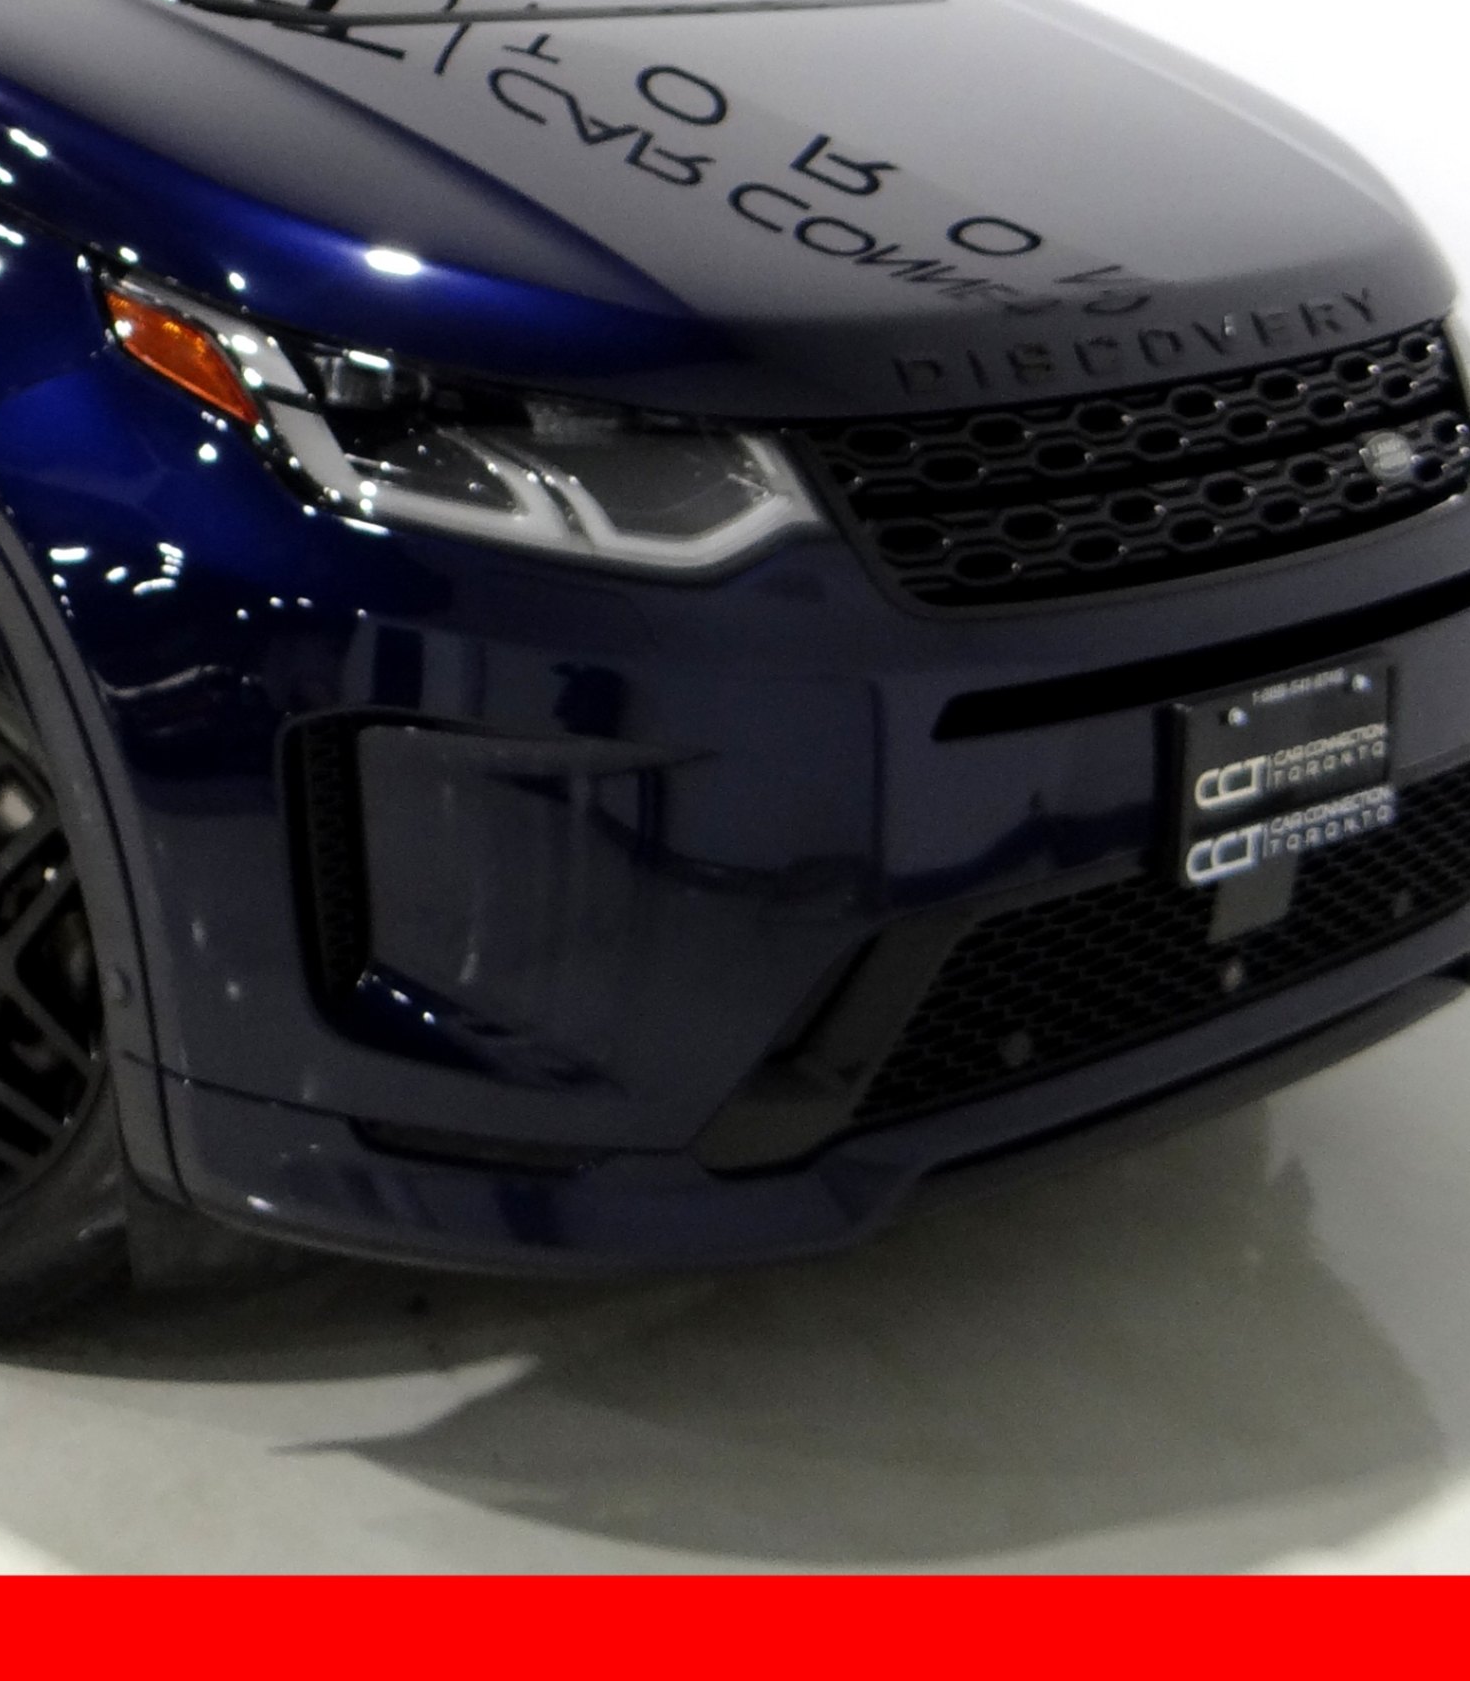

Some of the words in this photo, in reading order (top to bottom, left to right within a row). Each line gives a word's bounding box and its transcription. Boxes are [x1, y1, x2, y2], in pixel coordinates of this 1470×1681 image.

[892, 287, 1380, 396] DISCOVERY
[1195, 755, 1268, 811] CCT
[1273, 741, 1386, 789] TORONTO
[1186, 823, 1265, 886] CCT
[1270, 804, 1395, 855] TORONTO
